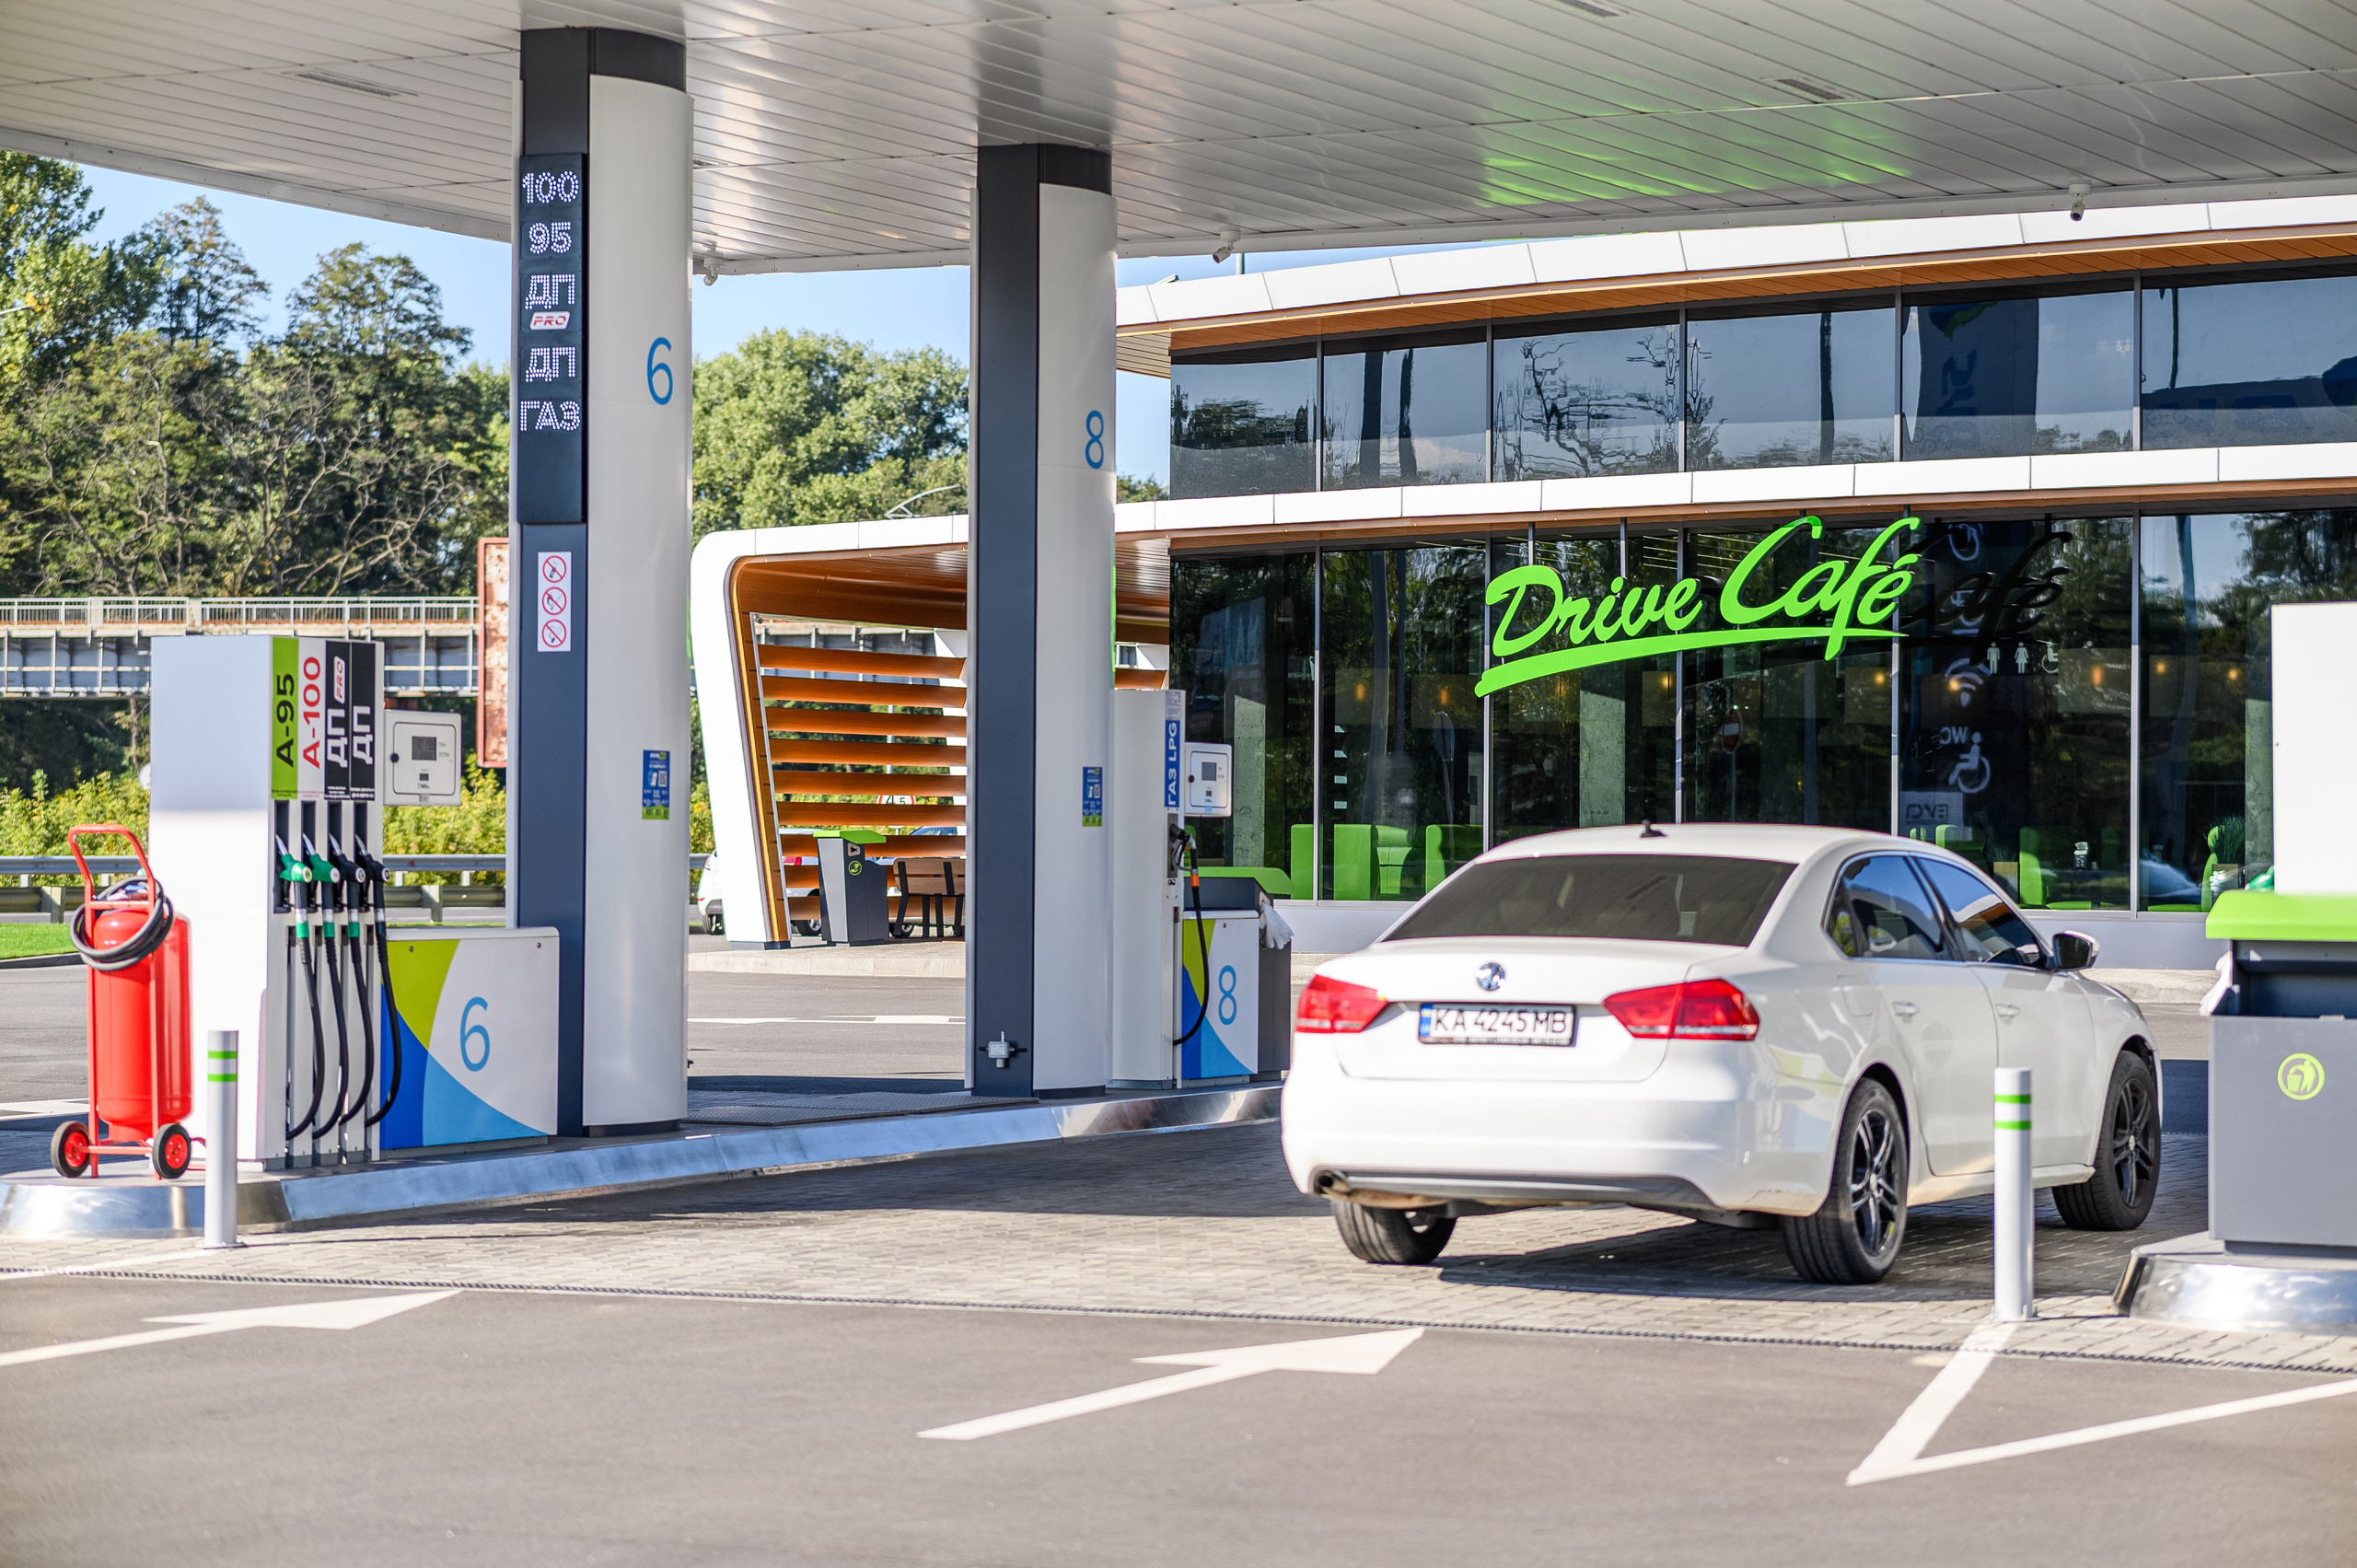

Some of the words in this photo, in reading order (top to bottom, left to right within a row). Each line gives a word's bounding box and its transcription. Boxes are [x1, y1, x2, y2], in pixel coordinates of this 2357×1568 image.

[521, 170, 580, 204] 100
[528, 221, 573, 255] 95
[524, 273, 576, 310] ДП
[532, 315, 567, 326] PRO
[524, 346, 576, 383] ДП
[646, 336, 674, 405] 6
[519, 400, 582, 432] ГАЗ
[1085, 410, 1105, 470] 8
[1485, 563, 1703, 658] Drive
[1718, 515, 1922, 661] Café
[335, 660, 344, 700] PRO
[327, 707, 348, 768] ДП
[352, 705, 374, 765] ДП
[1167, 722, 1178, 762] LPG
[1167, 767, 1178, 806] ГАЗ
[1217, 964, 1238, 1026] 8
[459, 995, 492, 1073] 6
[1474, 1009, 1527, 1033] 4245
